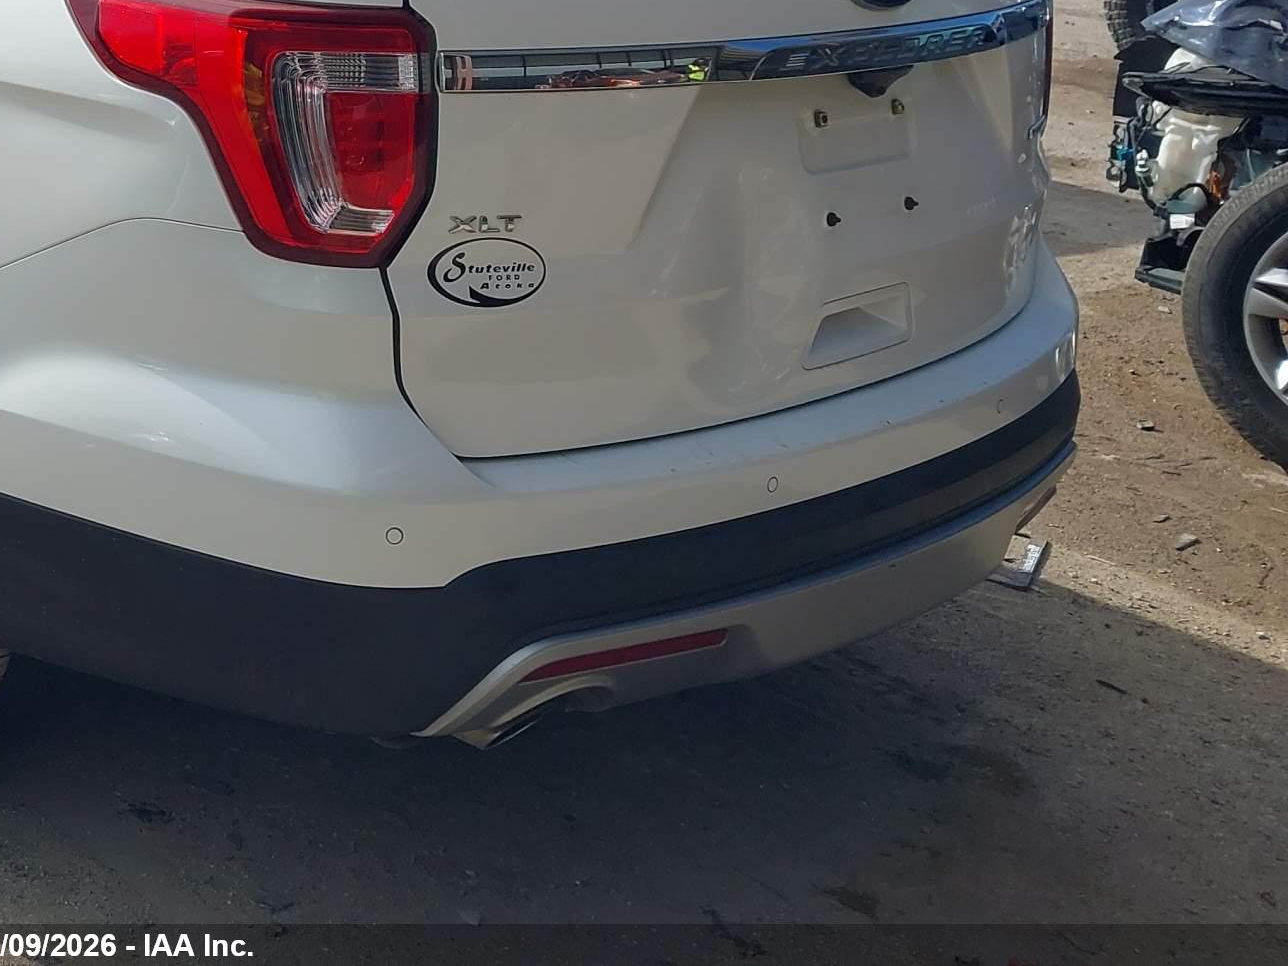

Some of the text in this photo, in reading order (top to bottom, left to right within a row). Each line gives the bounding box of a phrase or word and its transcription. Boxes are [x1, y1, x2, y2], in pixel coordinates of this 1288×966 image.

[779, 24, 987, 71] EXPLORER
[448, 214, 522, 234] XLT
[443, 252, 536, 283] Stuteville
[488, 274, 521, 282] FORD
